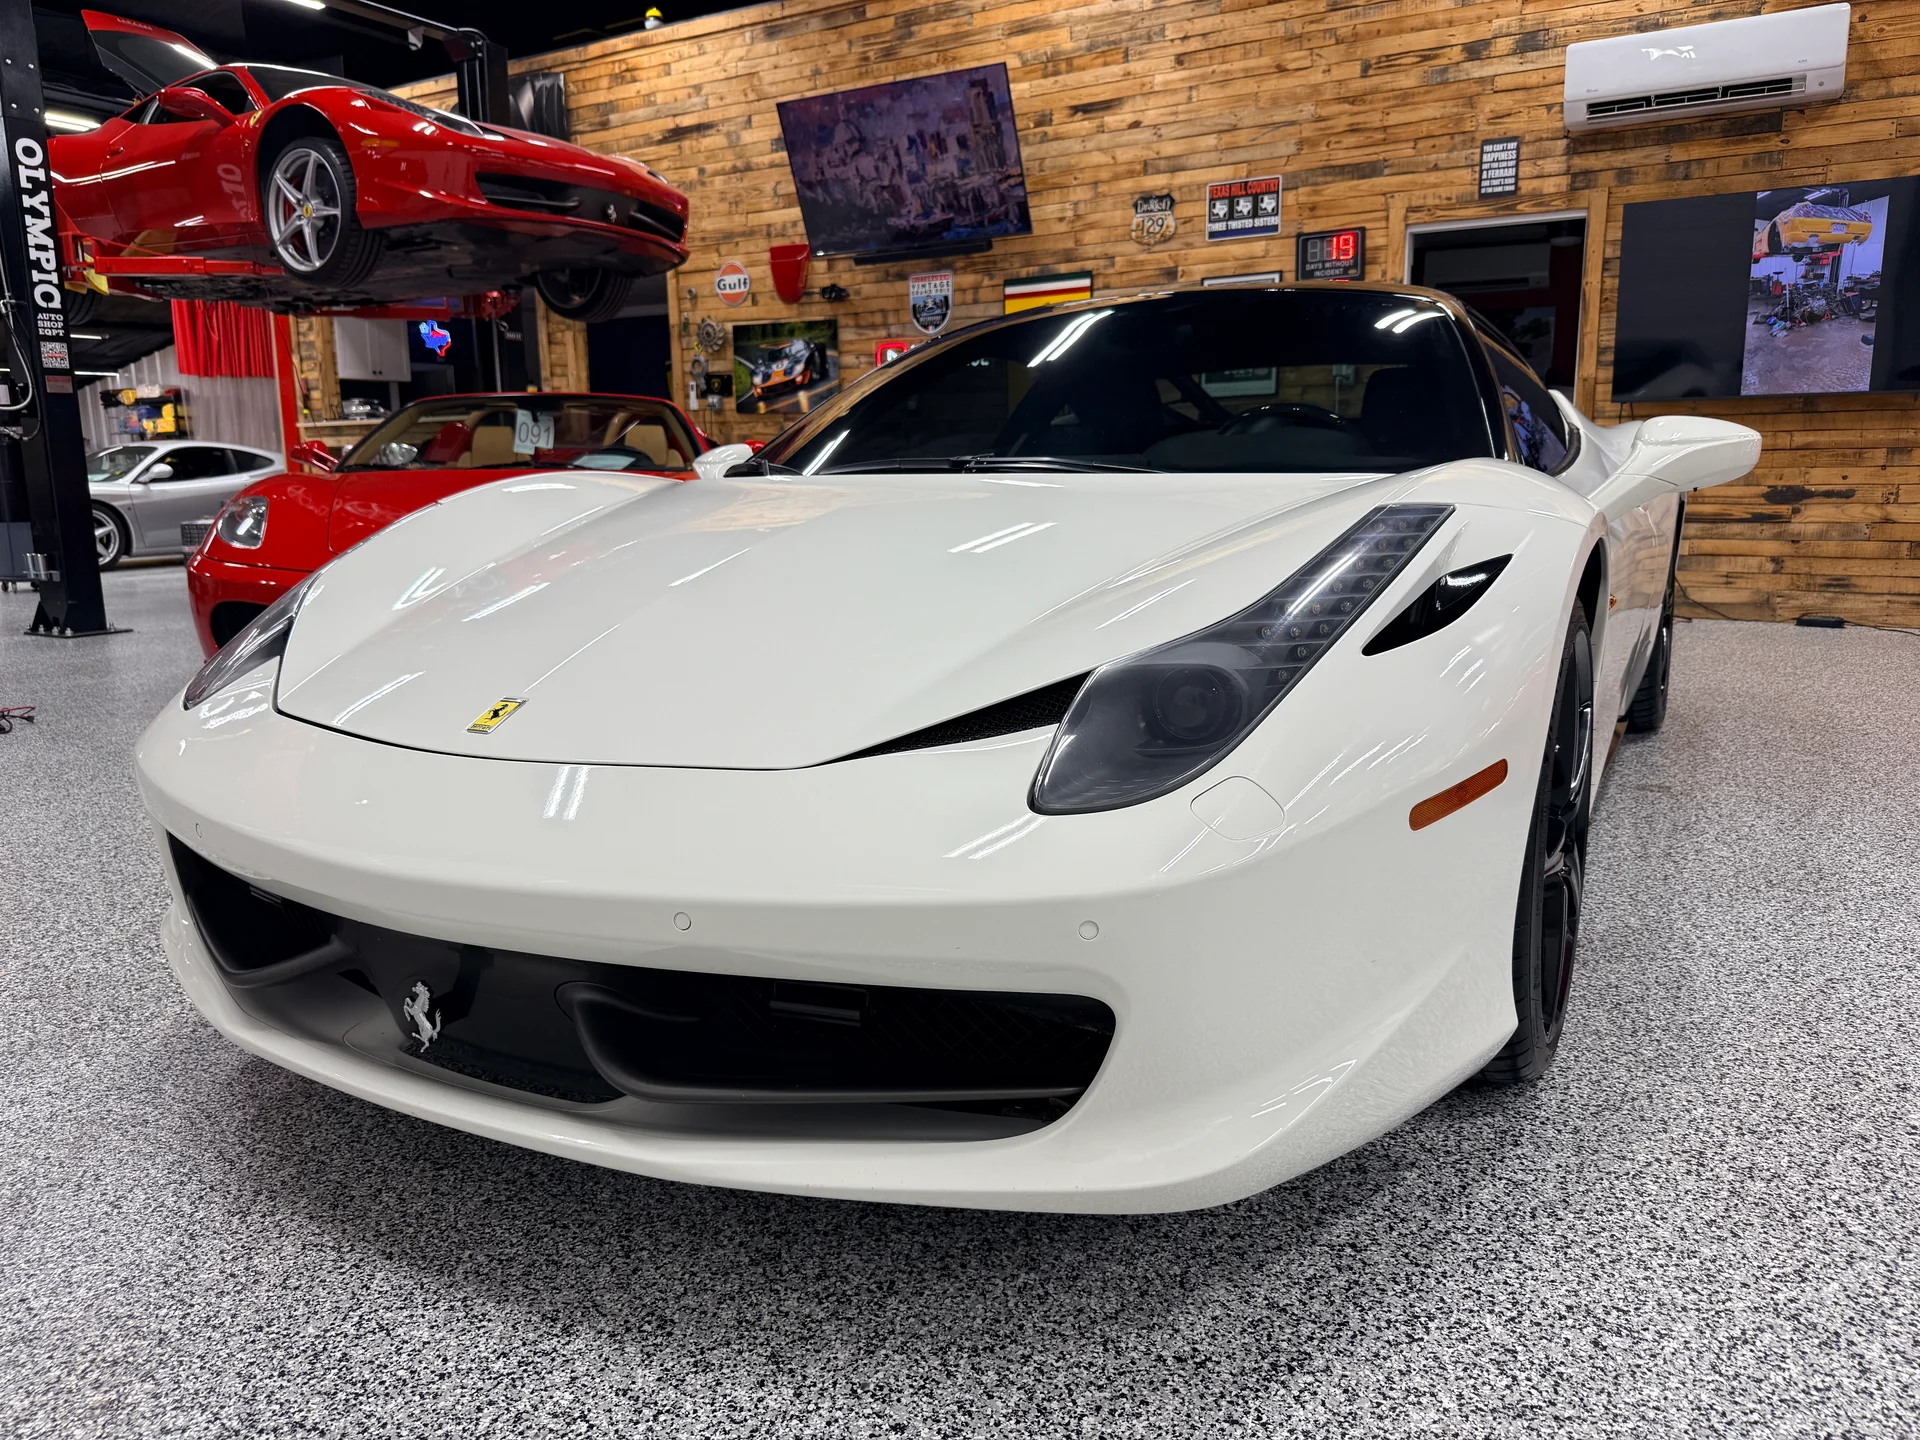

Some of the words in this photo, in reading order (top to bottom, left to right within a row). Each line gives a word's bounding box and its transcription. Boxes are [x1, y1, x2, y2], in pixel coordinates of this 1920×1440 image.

[1482, 150, 1517, 162] HAPPINESS
[1482, 170, 1488, 180] A
[1488, 167, 1516, 178] FERRARI
[1209, 184, 1230, 200] TEXAS
[1230, 182, 1246, 196] HILL
[1246, 178, 1279, 195] COUNTRY
[15, 137, 62, 309] OLYMPIC
[1141, 216, 1165, 236] 129
[1207, 222, 1228, 232] THREE
[1228, 218, 1254, 230] TWISTED
[1254, 216, 1280, 227] SISTERS
[1331, 233, 1355, 260] 19
[1306, 262, 1323, 271] DAYS
[1324, 259, 1354, 268] WITHOUT
[1314, 268, 1344, 277] INCIDENT
[717, 278, 748, 290] Gulf
[912, 280, 950, 290] VINTAGE
[37, 312, 64, 320] AUTO
[38, 320, 64, 329] SHOP
[39, 328, 65, 336] EQPT
[518, 422, 550, 446] 091
